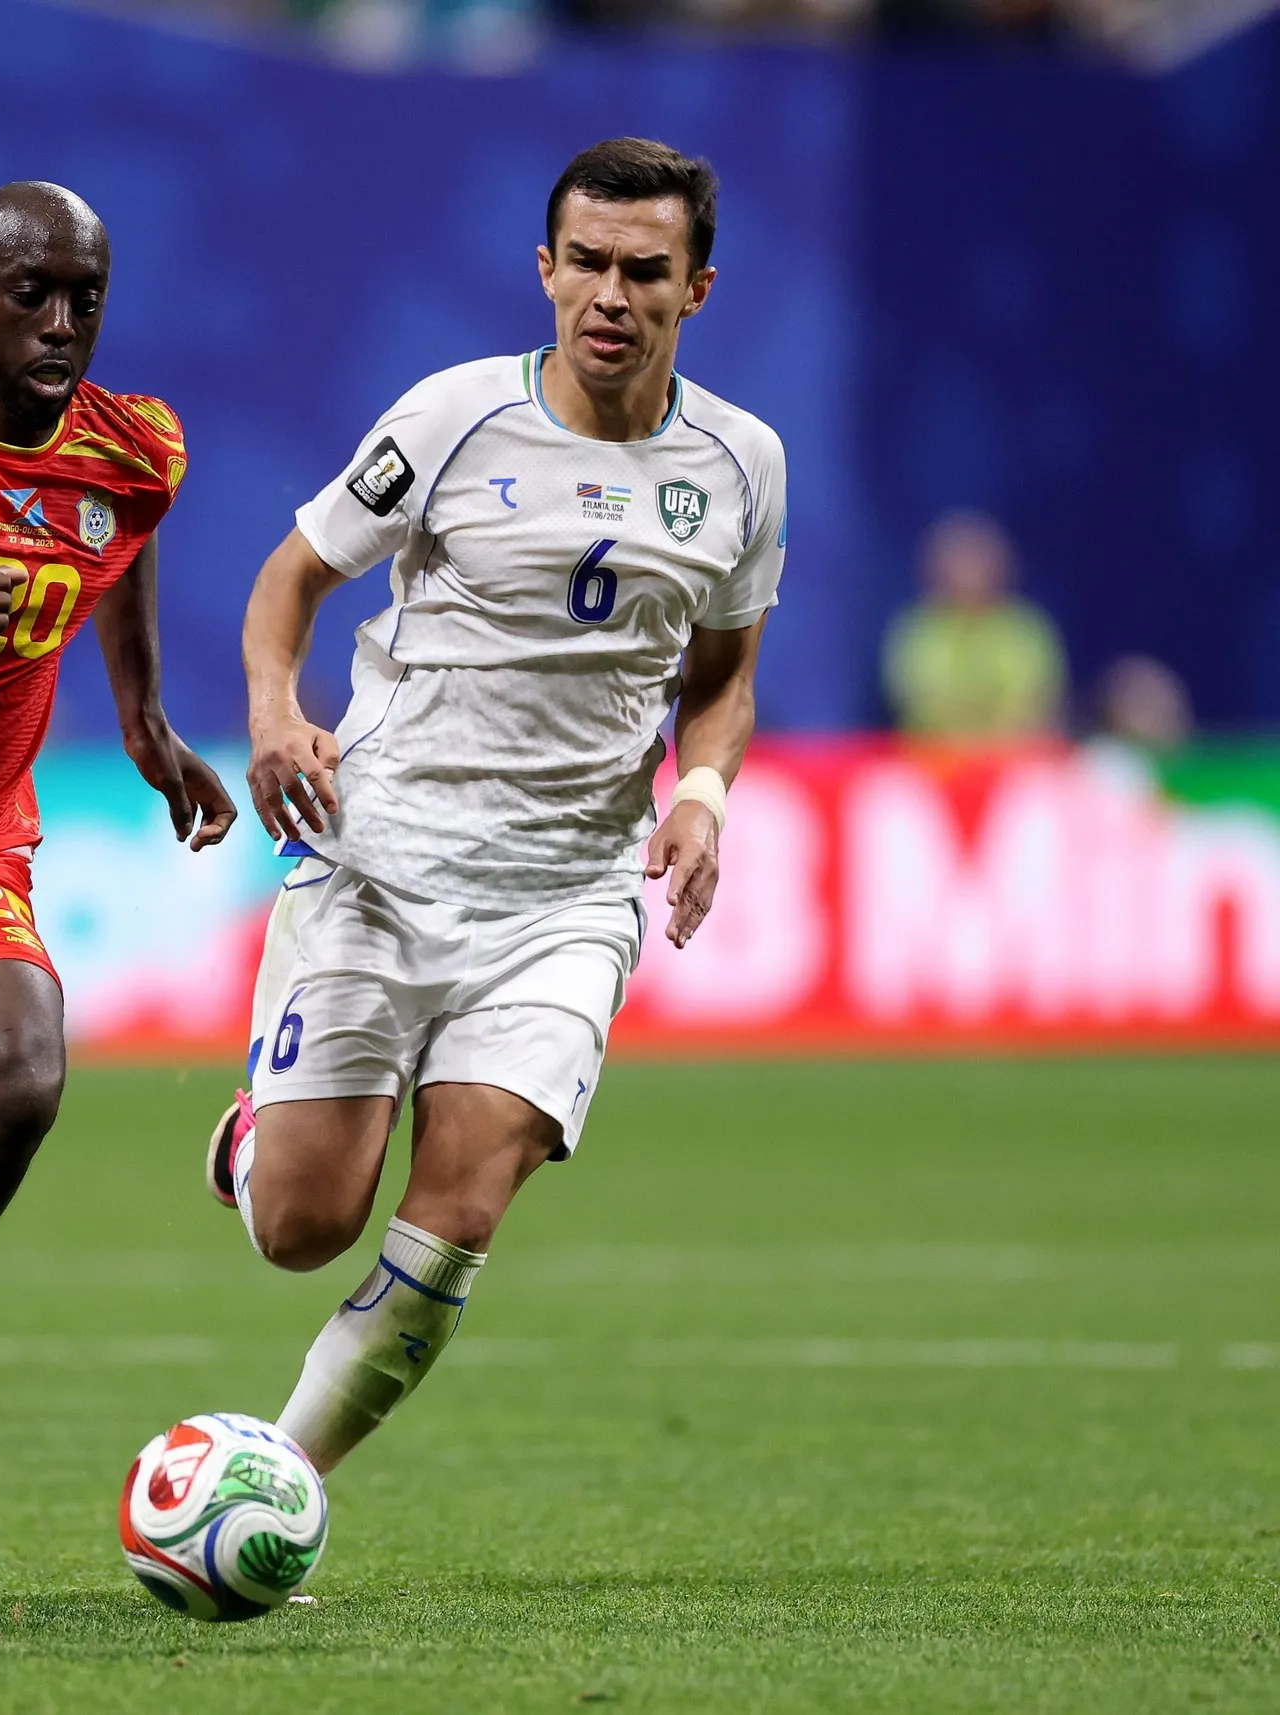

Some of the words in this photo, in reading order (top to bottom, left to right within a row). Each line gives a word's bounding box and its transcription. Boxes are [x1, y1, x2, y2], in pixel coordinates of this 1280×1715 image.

[352, 482, 377, 506] 2026
[664, 489, 701, 517] UFA
[582, 510, 623, 521] 27/06/2026
[612, 503, 625, 512] USA
[35, 538, 54, 548] 2026
[86, 531, 109, 544] FECOFA
[567, 539, 618, 624] 6
[268, 985, 308, 1075] 6
